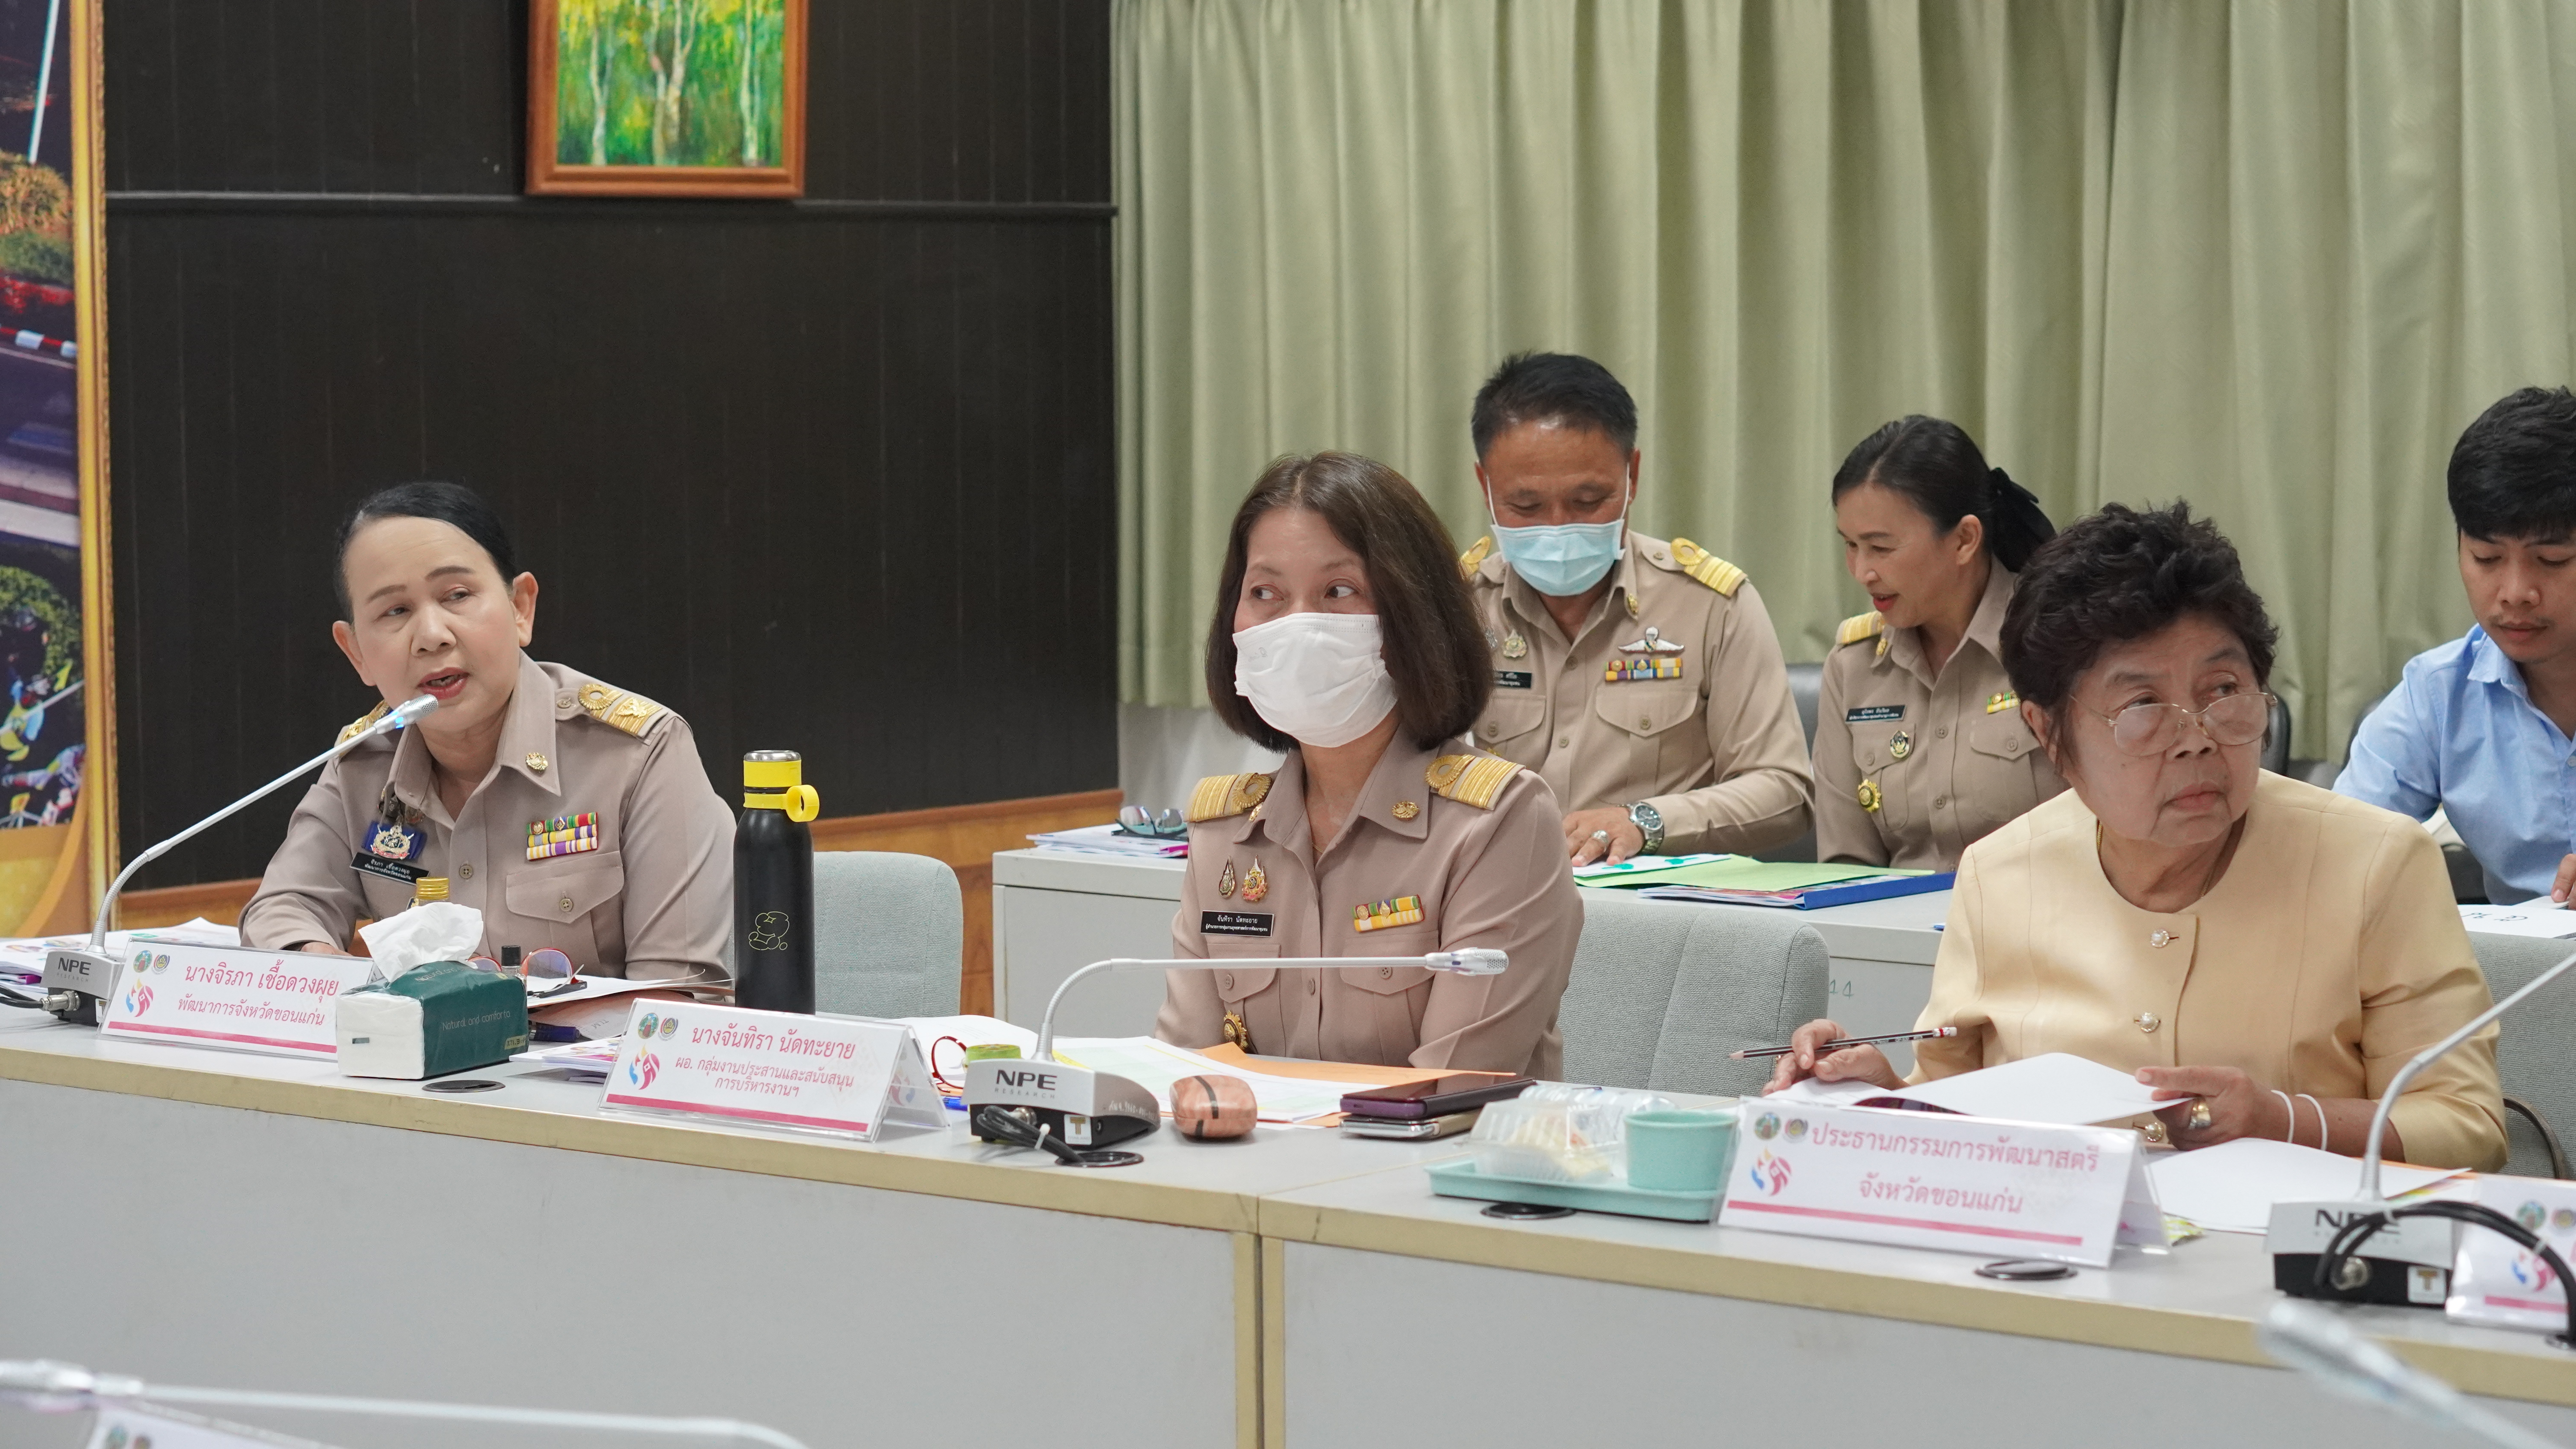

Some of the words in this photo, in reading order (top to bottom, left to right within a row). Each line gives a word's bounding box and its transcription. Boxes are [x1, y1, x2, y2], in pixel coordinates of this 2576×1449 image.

[57, 972, 89, 982] RESEARCH
[58, 957, 91, 976] NPE
[185, 961, 254, 987] นางจิรภา
[258, 959, 340, 1003] เชื้อดวงผุย
[178, 993, 325, 1026] พัฒนาการจังหวัดขอนแก่น
[442, 1017, 466, 1031] Natural
[468, 1014, 480, 1025] and
[692, 1023, 774, 1051] นางจันทิรา
[780, 1029, 856, 1060] นัดทะยาย
[675, 1056, 693, 1069] ผอ.
[697, 1056, 855, 1091] กลุ่มงานประสานและสนับสนุน
[996, 1070, 1057, 1091] NPE
[715, 1076, 800, 1097] การบริหารงานฯ
[994, 1087, 1055, 1099] RESEARCH
[1070, 1117, 1086, 1135] T
[1812, 1122, 2099, 1172] ประธานกรรมการพัฒนาสตรี
[1859, 1172, 2023, 1214] จังหวัดขอนแก่น
